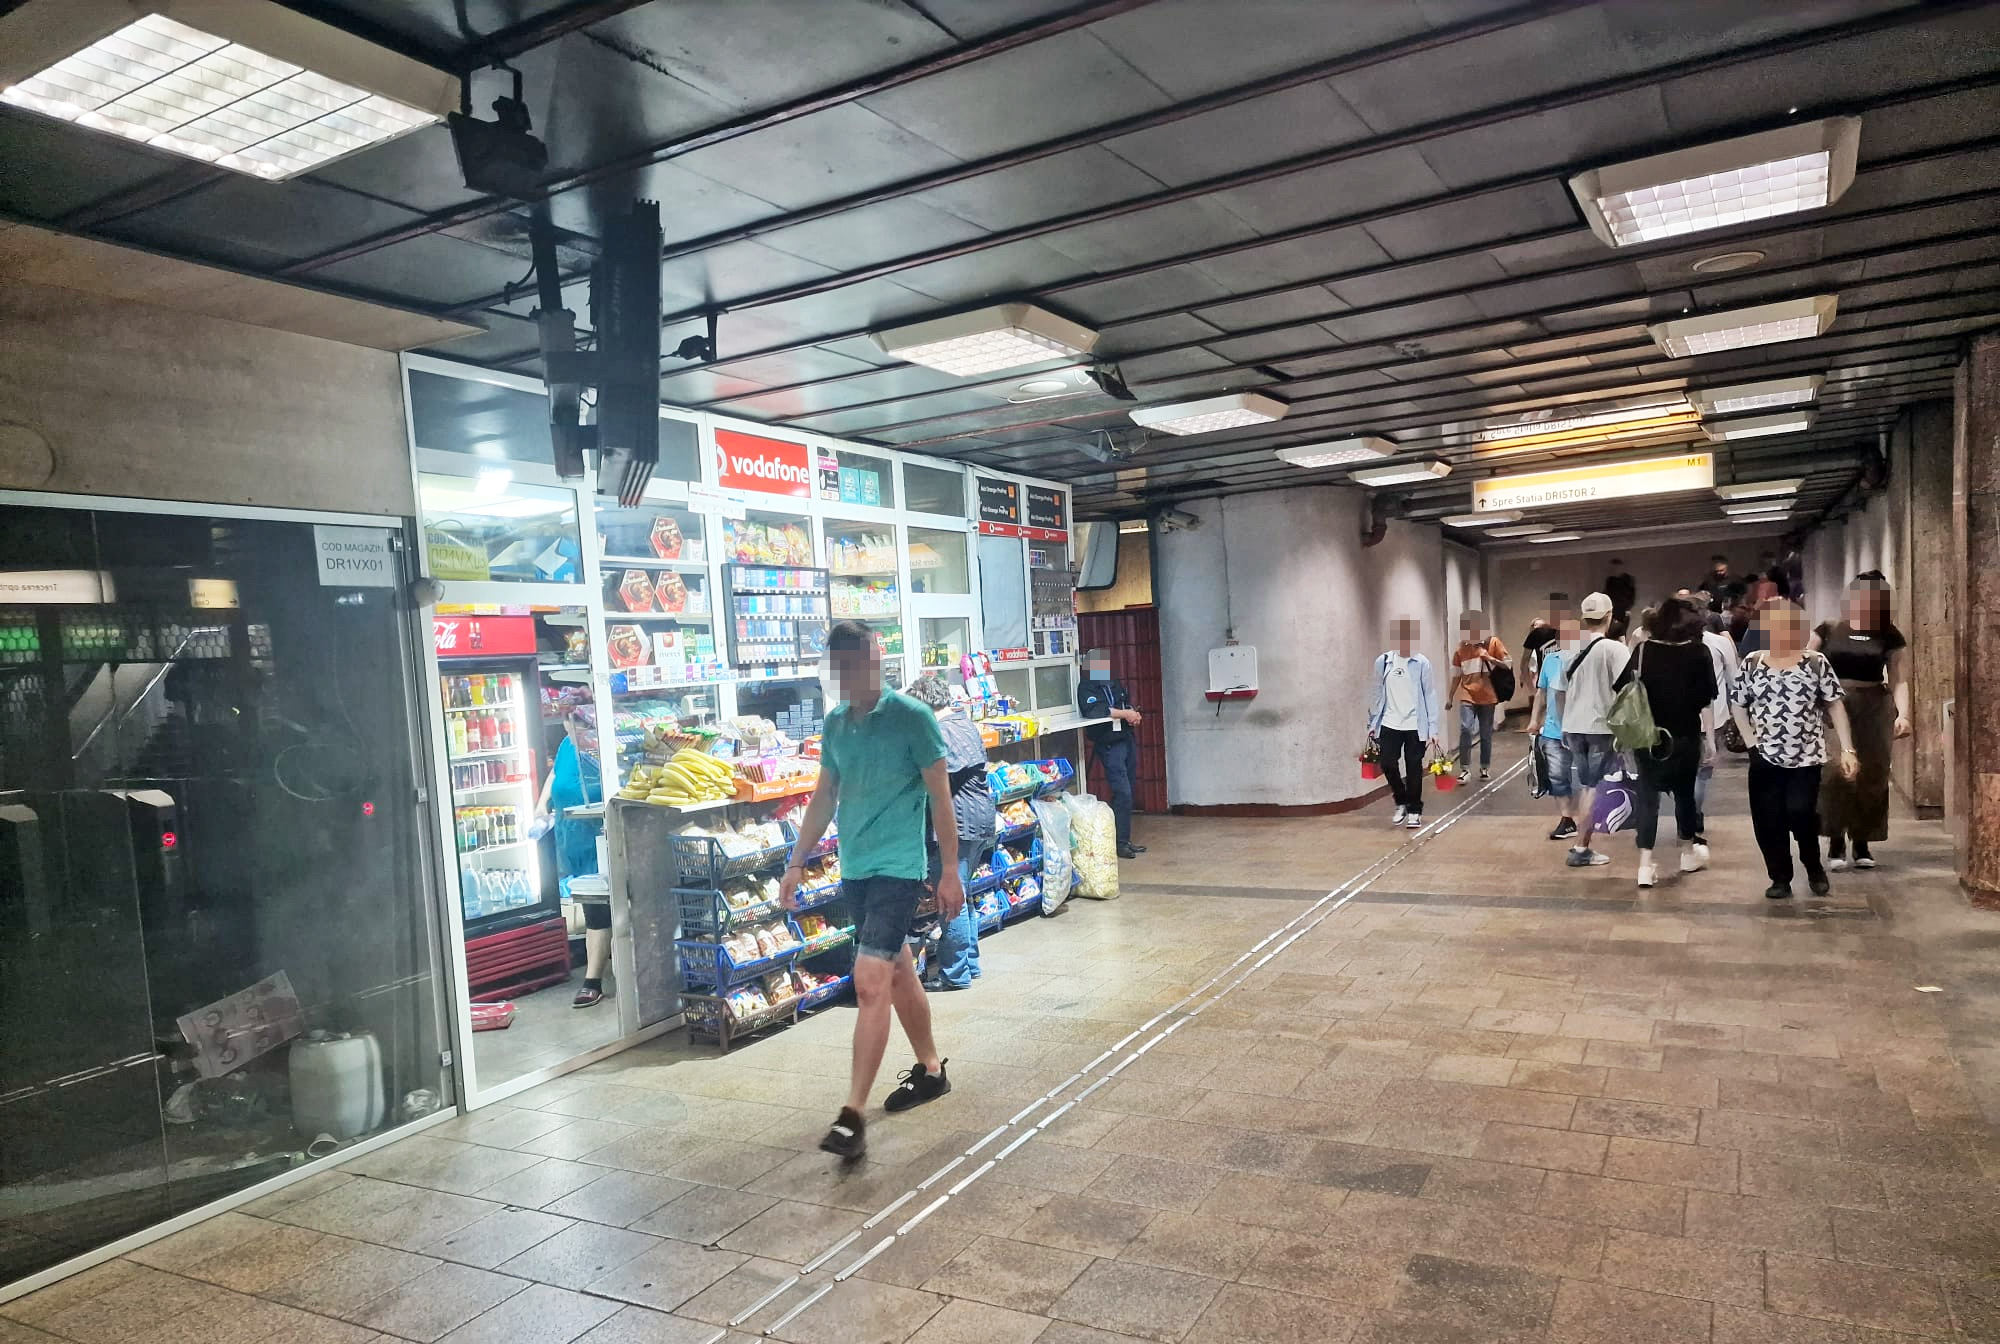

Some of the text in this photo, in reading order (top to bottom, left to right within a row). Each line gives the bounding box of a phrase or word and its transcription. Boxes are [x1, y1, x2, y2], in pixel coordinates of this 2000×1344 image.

[731, 454, 810, 484] vodafone
[1492, 498, 1513, 508] Spre
[1545, 487, 1588, 501] DRISTOR
[1590, 486, 1597, 496] 2
[321, 542, 384, 553] COD MAGAZIN
[326, 557, 383, 571] DR1VX01
